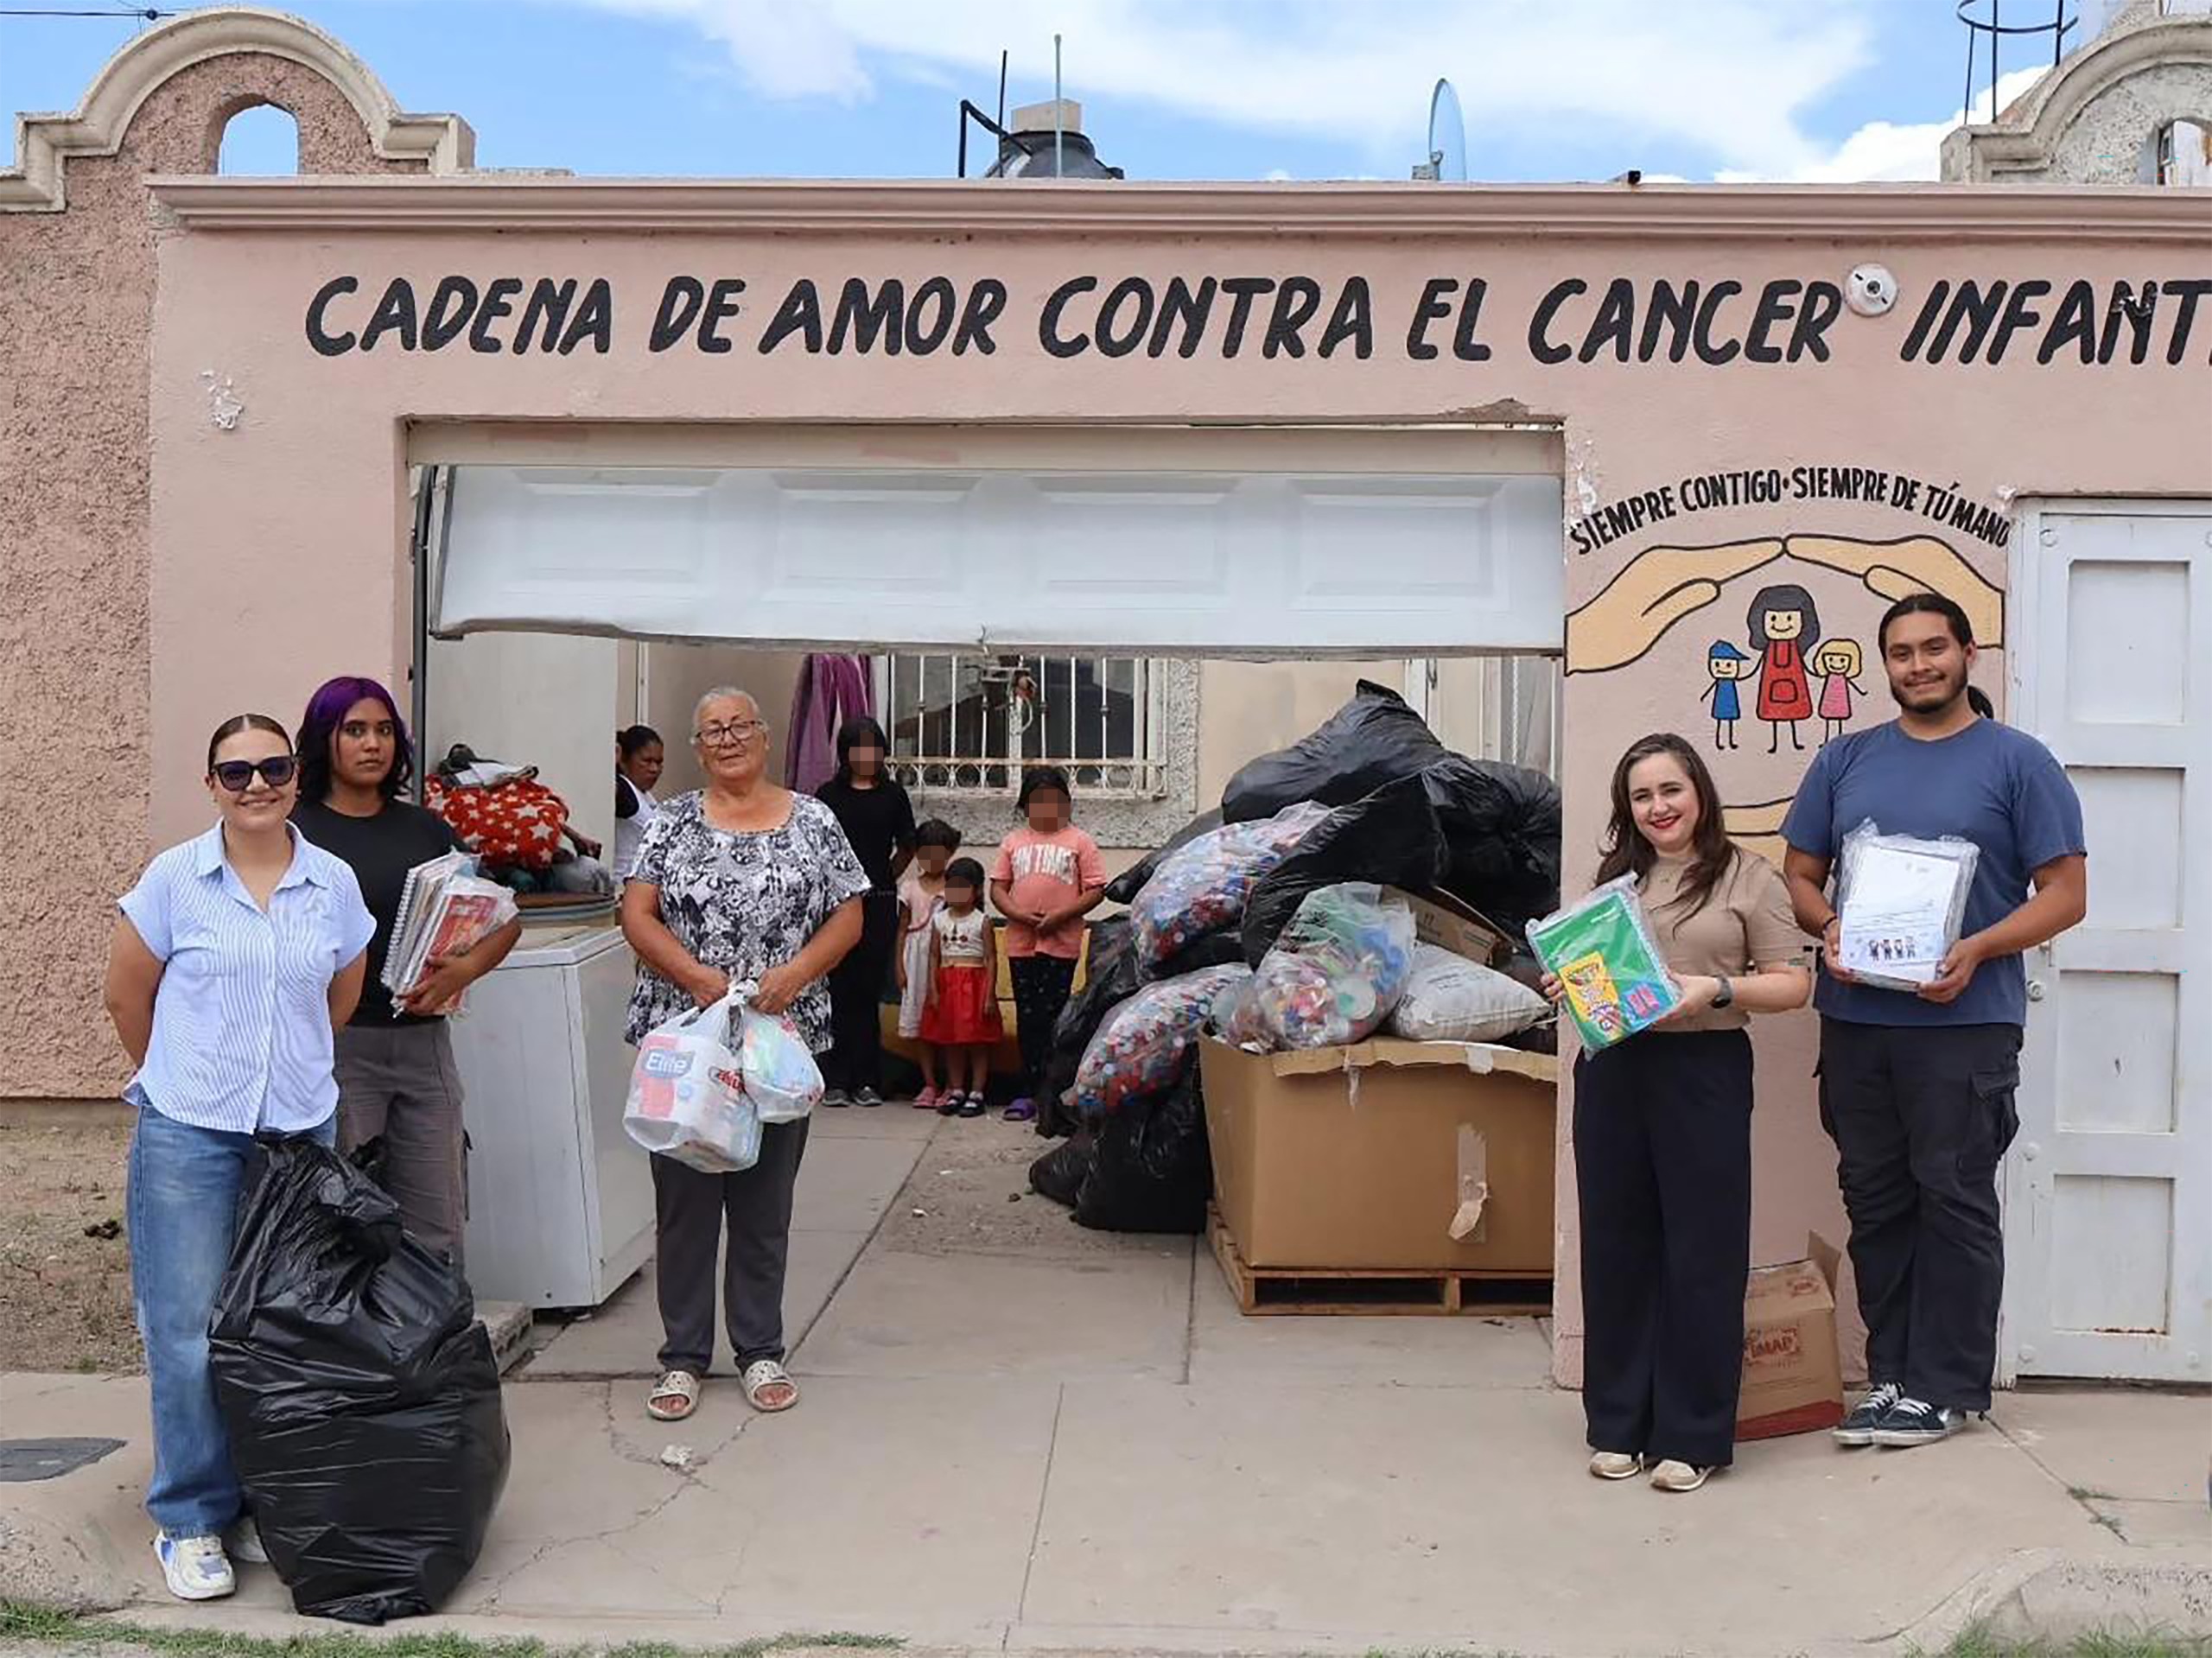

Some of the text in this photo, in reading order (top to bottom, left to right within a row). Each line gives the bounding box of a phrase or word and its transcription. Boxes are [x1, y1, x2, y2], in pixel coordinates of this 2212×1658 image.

[305, 276, 2212, 366] CADENA DE AMOR CONTRA EL CANCER INFANT
[1569, 486, 1677, 556] SIEMPRE
[1890, 475, 1922, 511] DE
[1922, 480, 1961, 522] TÚ
[1948, 497, 2011, 549] MANO
